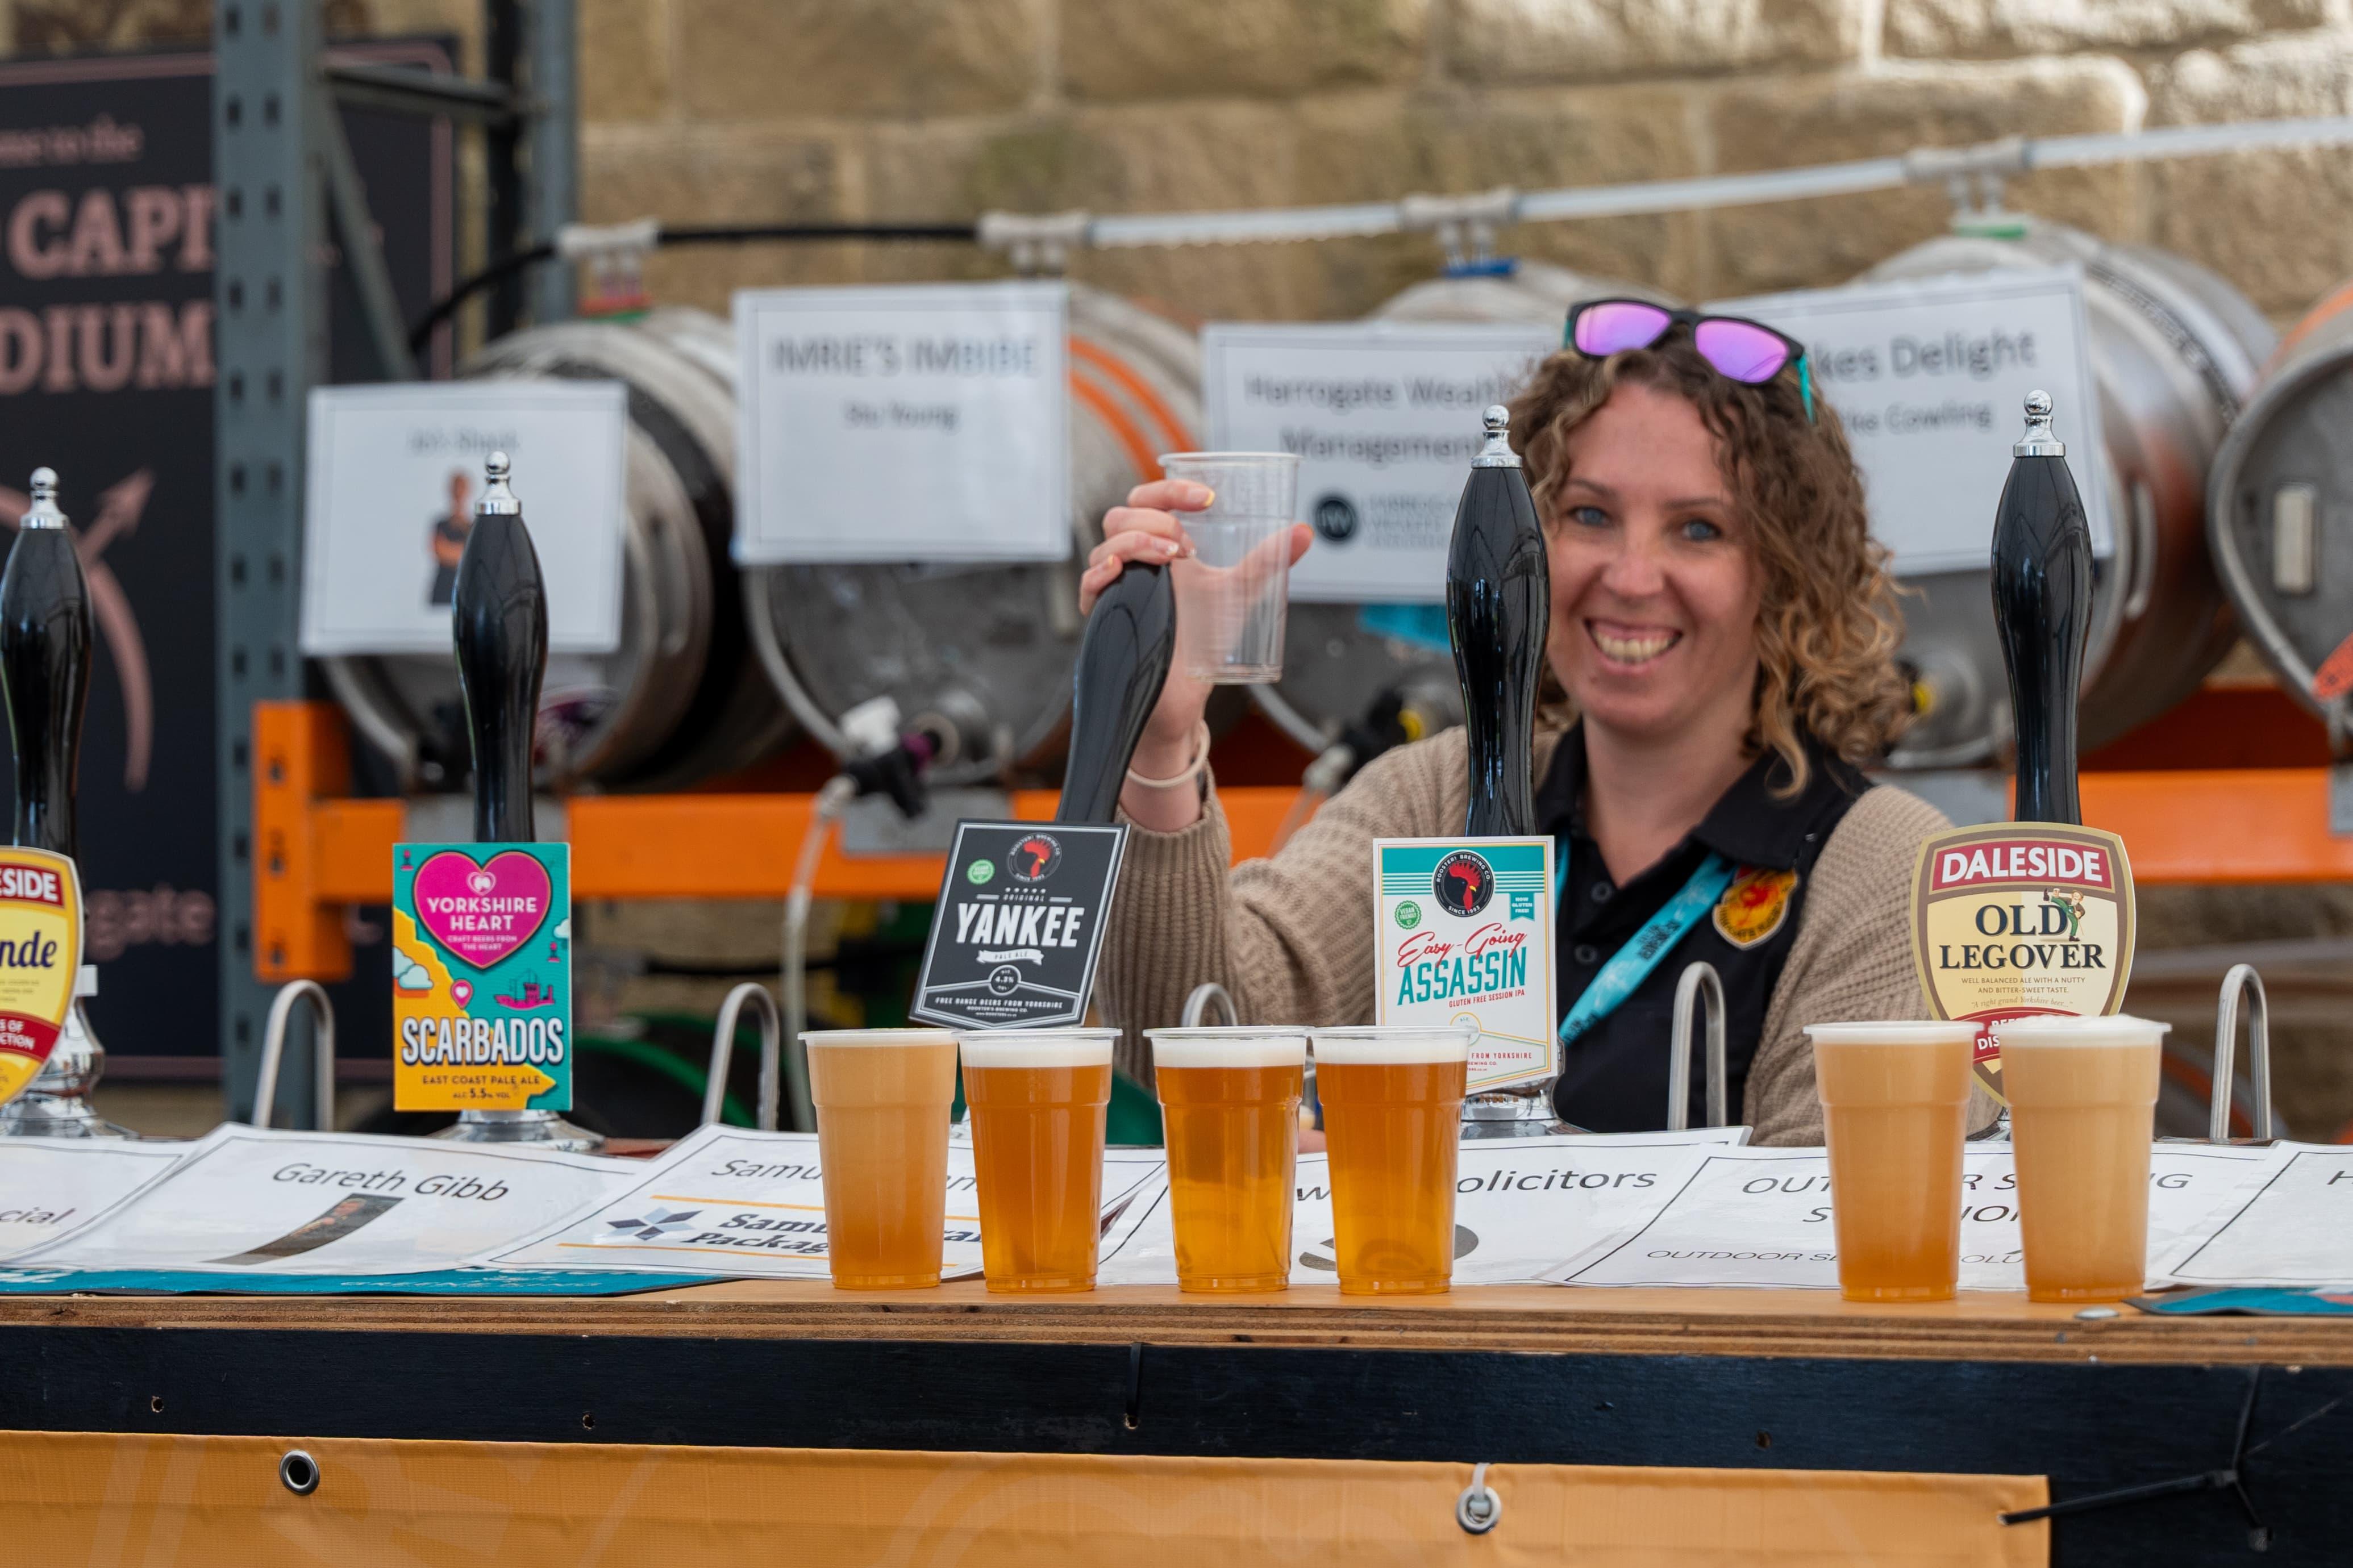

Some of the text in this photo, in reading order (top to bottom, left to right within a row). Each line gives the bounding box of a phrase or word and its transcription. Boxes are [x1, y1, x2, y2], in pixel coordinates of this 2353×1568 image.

[7, 182, 219, 280] CAPI
[1814, 330, 2038, 382] kes Delight
[1245, 375, 1396, 414] Harrogate
[1459, 854, 1486, 870] BREWING
[1942, 847, 2103, 883] DALESIDE
[0, 868, 59, 903] SIDE
[427, 897, 538, 914] YORKSHIRE
[1448, 905, 1466, 915] SINCE
[450, 915, 515, 931] HEART
[956, 902, 1085, 948] YANKEE
[1976, 904, 2068, 936] OLD
[1939, 944, 2107, 969] LEGOVER
[1397, 946, 1527, 1006] ASSASSIN
[1025, 1000, 1063, 1009] YORKSHIRE
[1449, 998, 1471, 1008] GLUTEN
[1488, 991, 1513, 1002] SESSION
[1981, 998, 1997, 1007] right
[1998, 996, 2018, 1006] grand
[402, 1017, 564, 1066] SCARBADOS
[423, 1075, 540, 1085] EAST COAST PALE ALE
[711, 1160, 822, 1179] Samu
[273, 1162, 509, 1201] Gareth Gibb
[1457, 1169, 1658, 1194] olicitors
[718, 1213, 828, 1234] Samu
[681, 1232, 829, 1254] Packag
[1647, 1250, 1804, 1262] OUTDOOR
